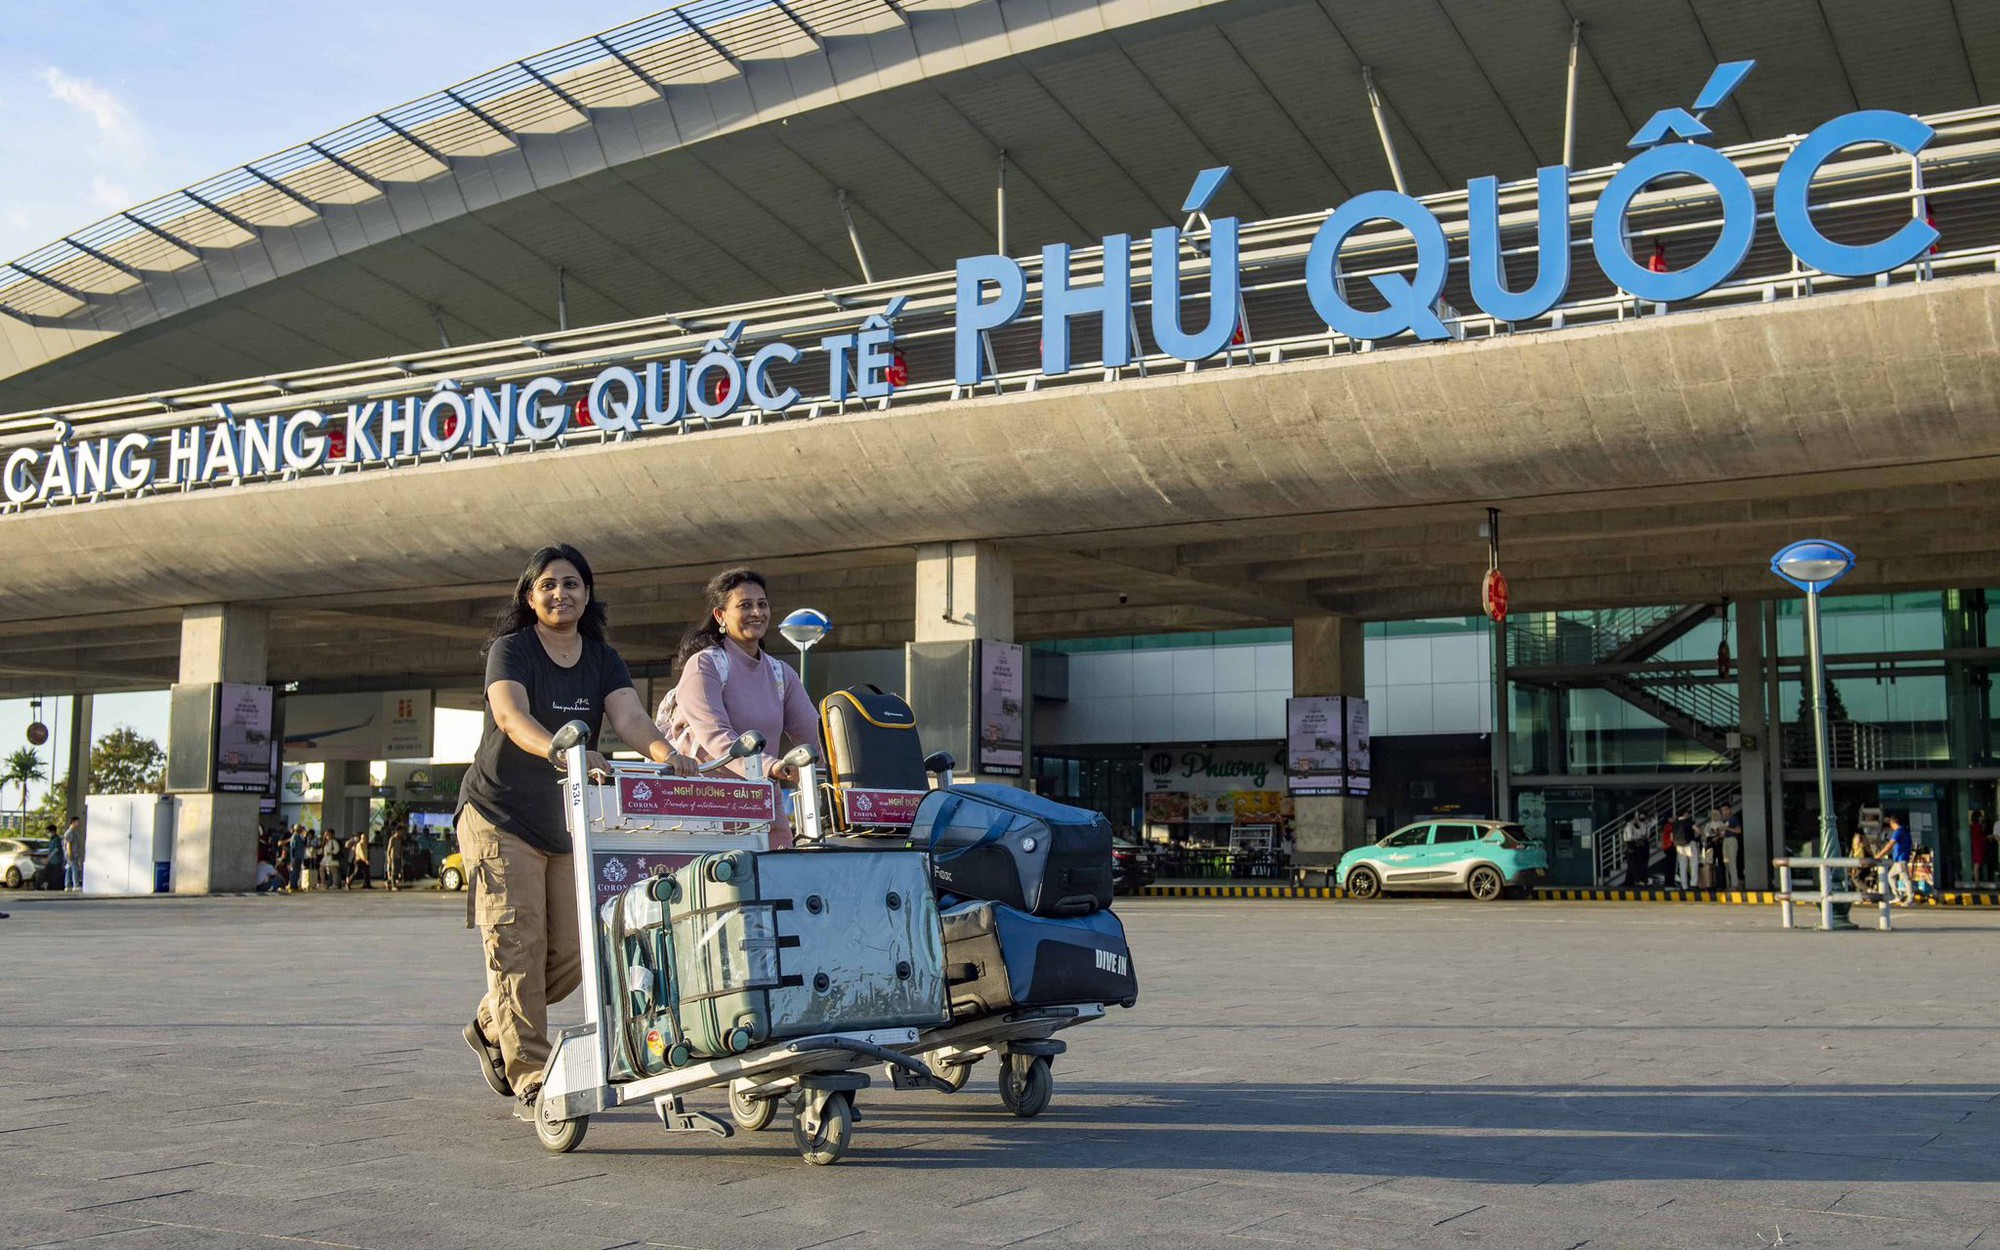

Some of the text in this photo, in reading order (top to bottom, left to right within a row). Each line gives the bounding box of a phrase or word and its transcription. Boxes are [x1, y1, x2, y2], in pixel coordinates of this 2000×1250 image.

[955, 59, 1941, 386] PHÚ QUỐC
[3, 295, 910, 503] CẢNG HÀNG KHÔNG QUỐC TẾ
[572, 783, 581, 806] 534
[674, 784, 694, 796] NGHỈ
[733, 787, 749, 798] GIẢI
[628, 801, 659, 809] CORONA
[664, 799, 689, 809] Paradise
[690, 801, 697, 811] of
[934, 865, 953, 882] Fox
[1095, 949, 1127, 977] DIVE IN
